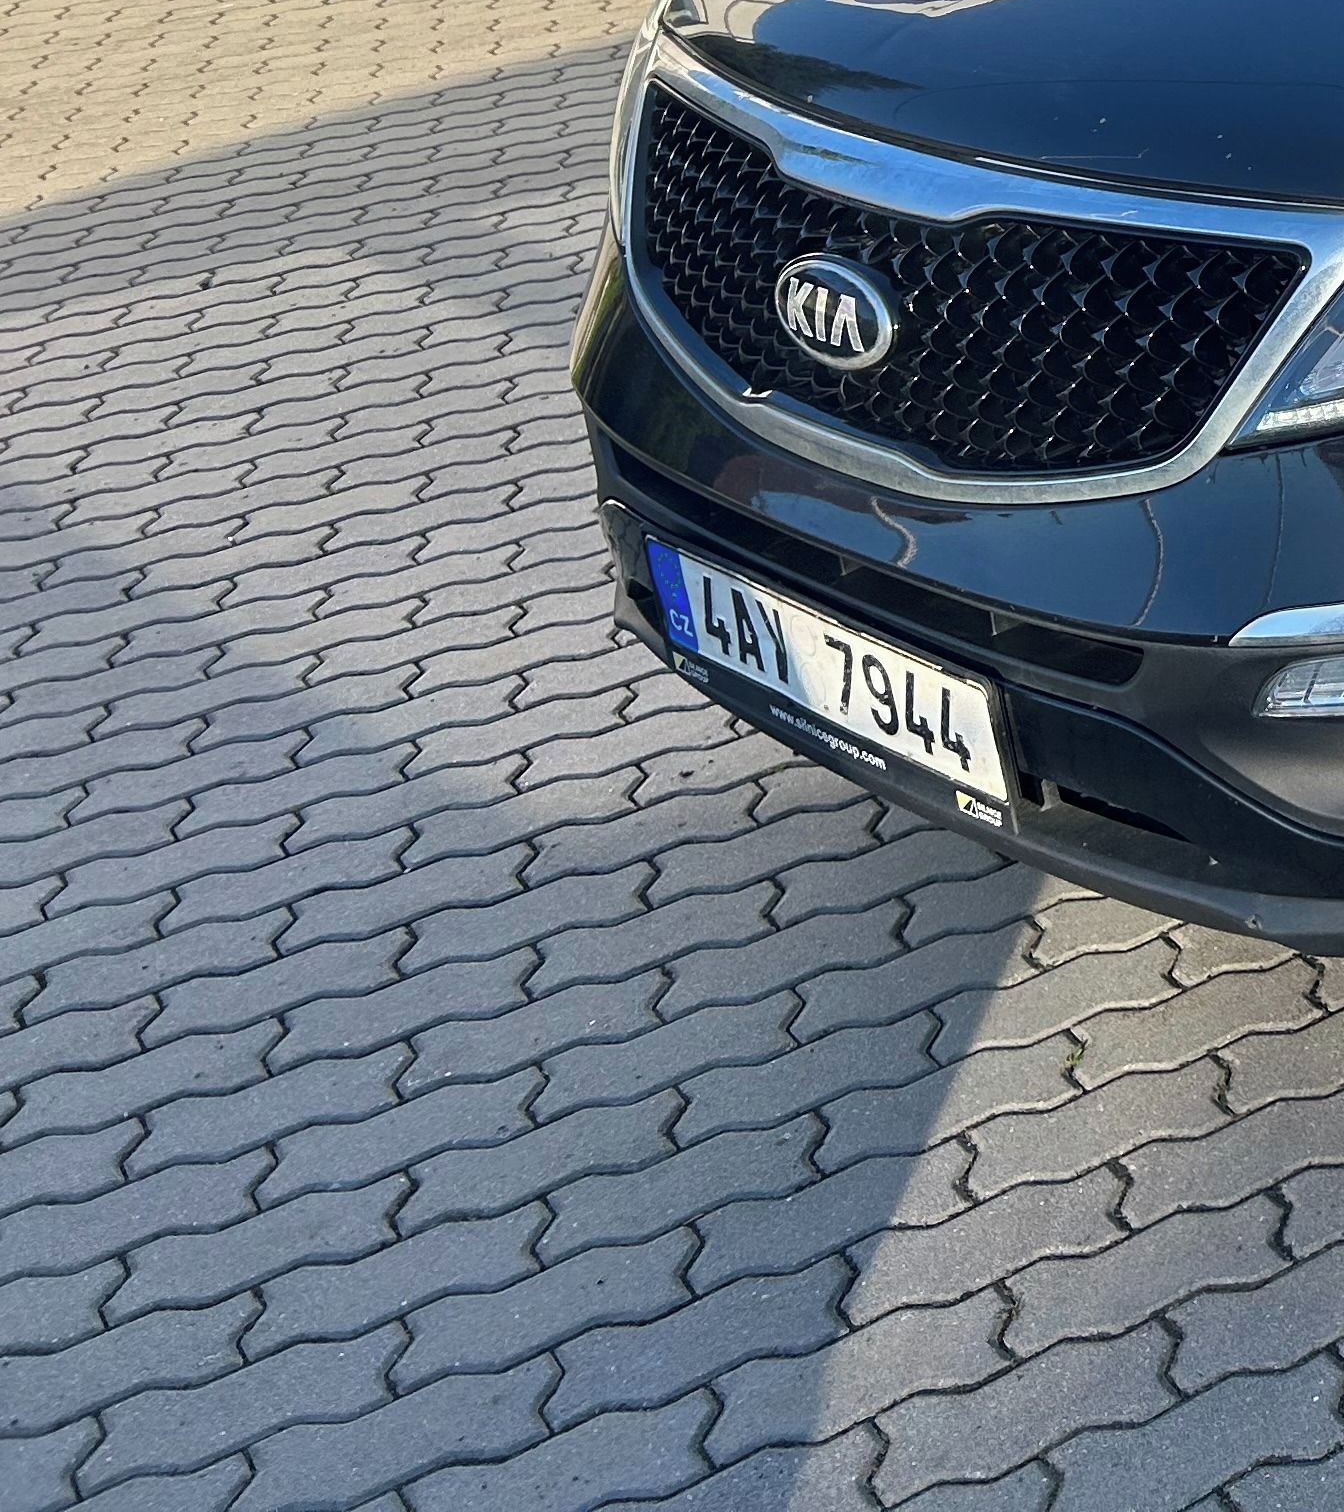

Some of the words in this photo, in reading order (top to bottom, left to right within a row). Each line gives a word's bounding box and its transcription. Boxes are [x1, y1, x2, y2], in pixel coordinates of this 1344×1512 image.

[786, 276, 865, 353] KIA
[669, 608, 694, 637] CZ
[702, 576, 789, 684] 4AY
[824, 633, 971, 772] 7944
